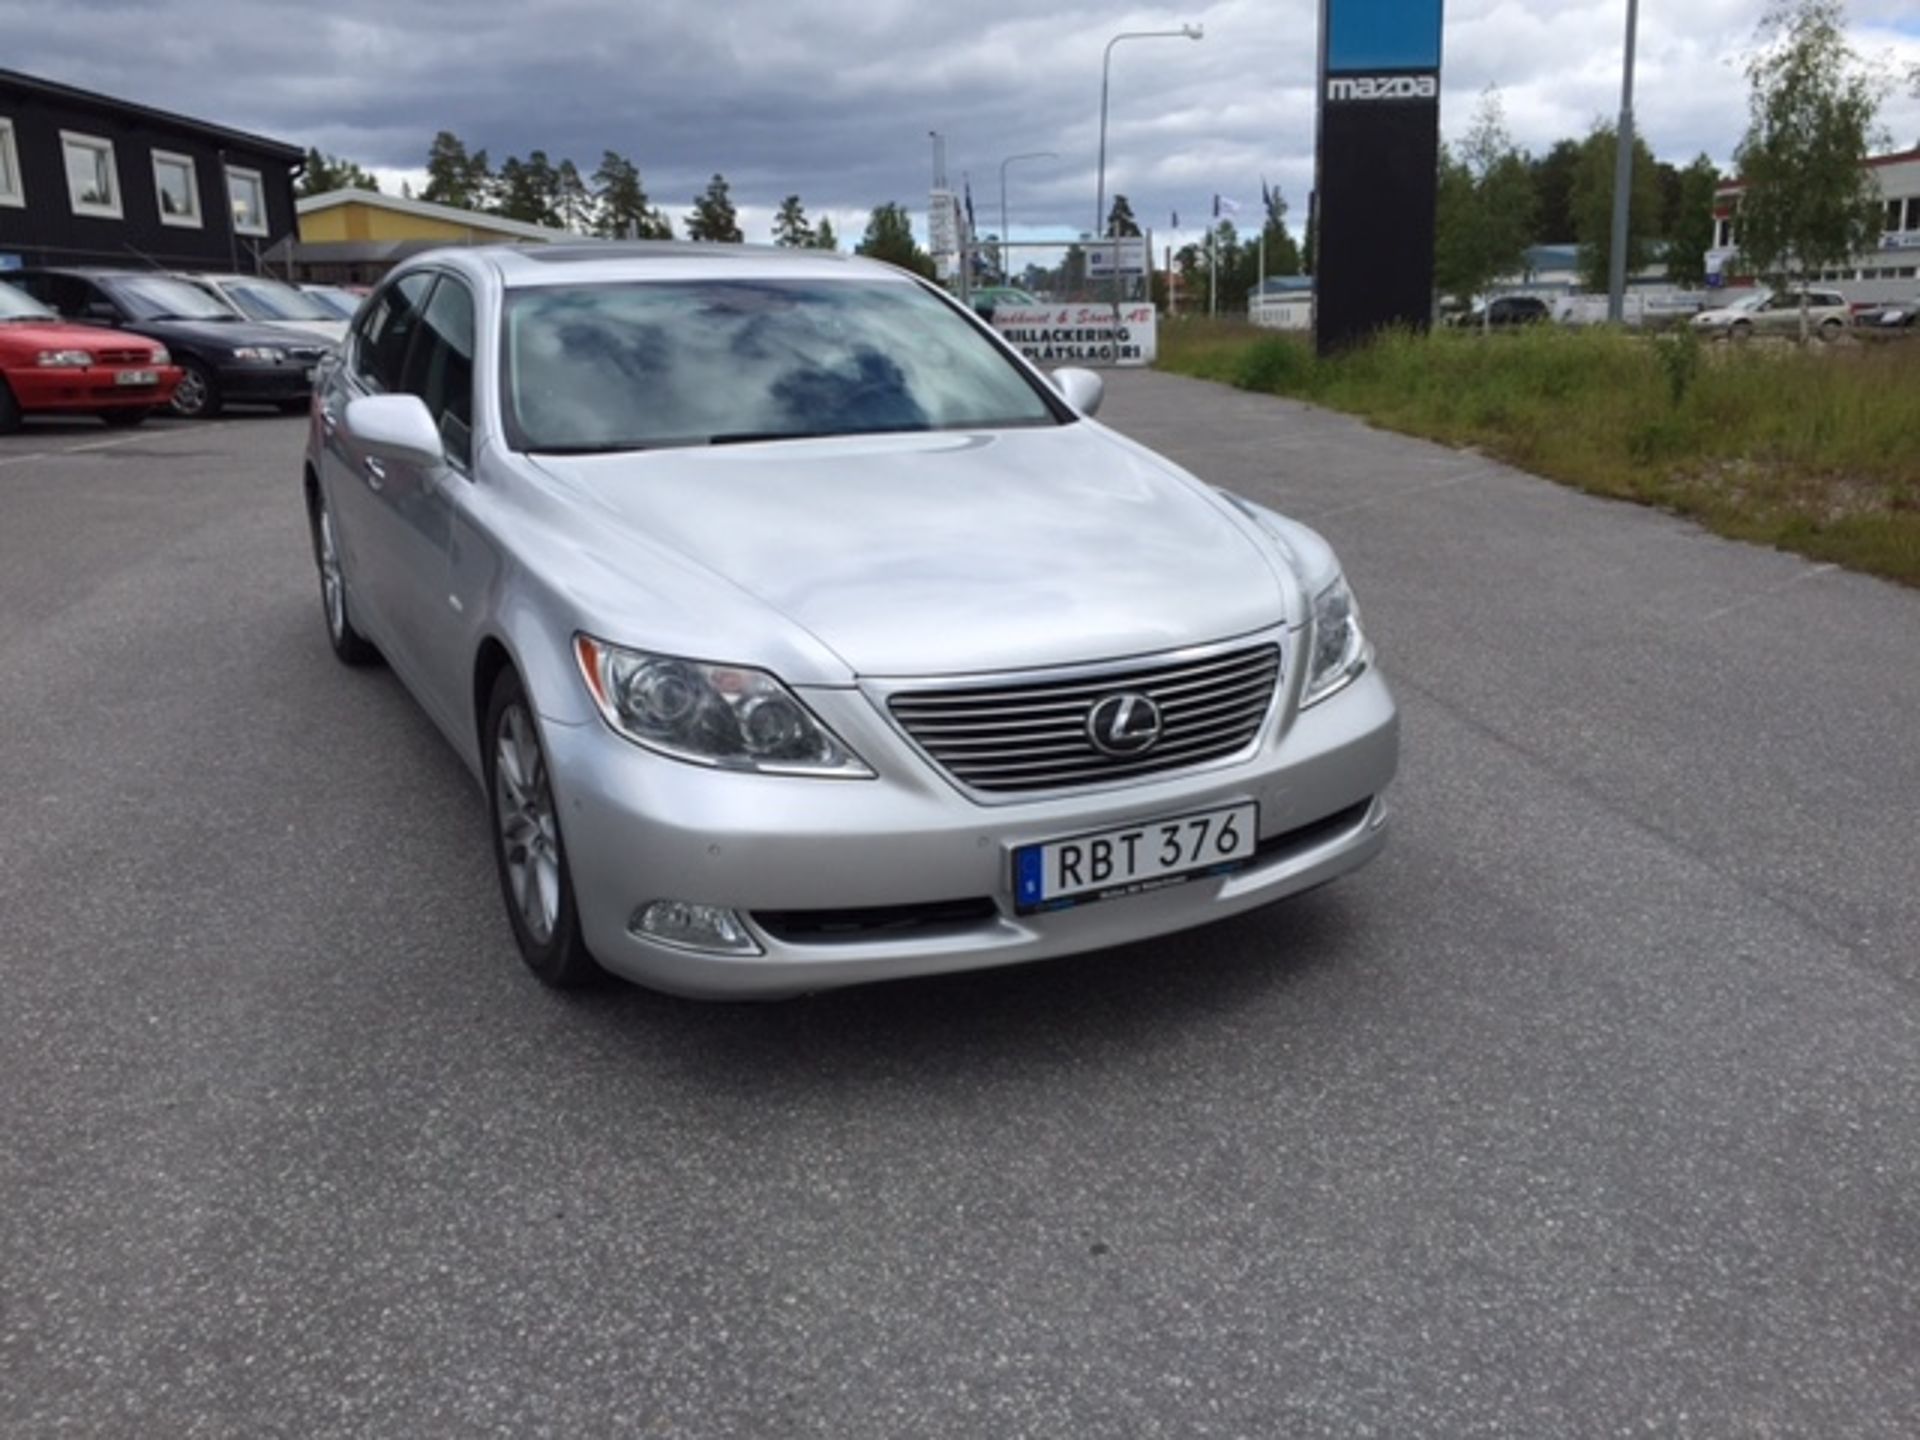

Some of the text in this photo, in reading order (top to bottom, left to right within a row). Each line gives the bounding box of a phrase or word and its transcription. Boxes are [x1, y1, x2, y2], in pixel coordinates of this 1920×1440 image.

[1328, 76, 1436, 100] mazda
[1056, 308, 1069, 325] &
[1003, 328, 1131, 342] BILLACKERING
[1058, 831, 1144, 889] RBT
[1159, 813, 1240, 868] 376
